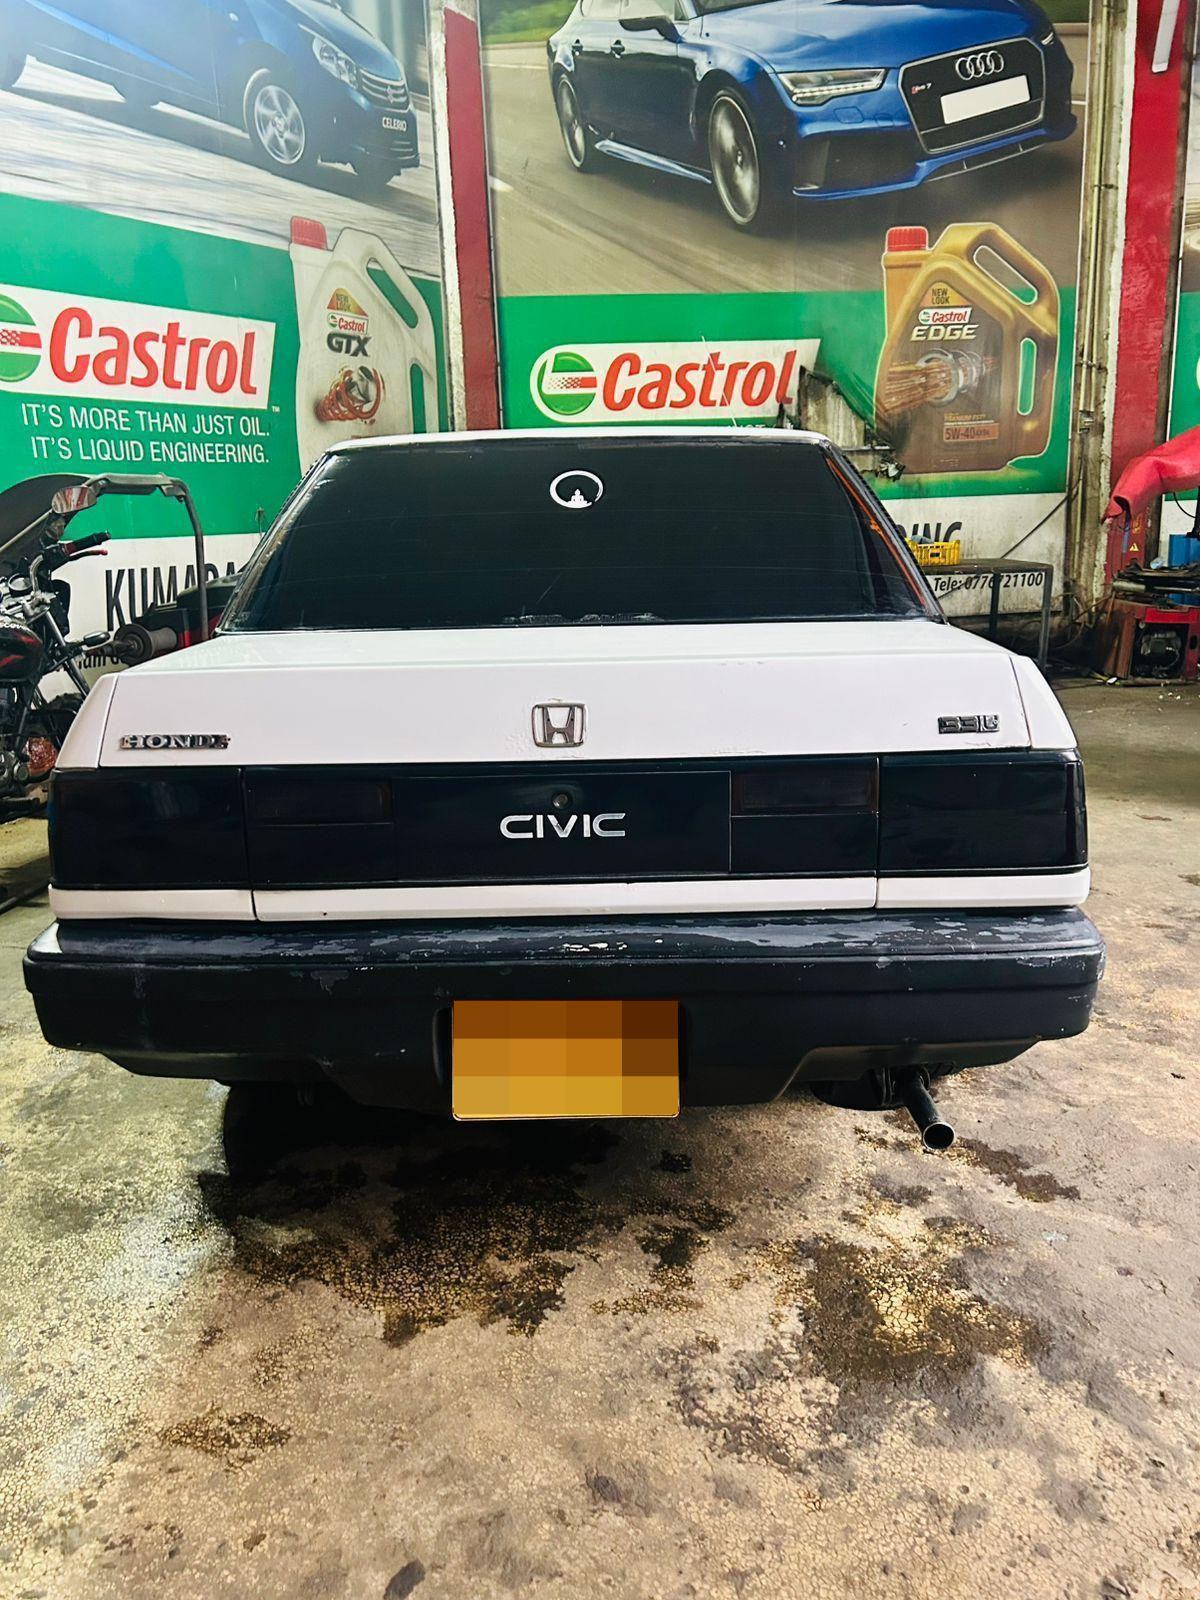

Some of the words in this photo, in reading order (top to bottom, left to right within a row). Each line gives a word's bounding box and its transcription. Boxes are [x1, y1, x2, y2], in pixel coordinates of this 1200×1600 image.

[932, 288, 948, 296] NEW
[338, 318, 365, 333] Castrol
[932, 311, 967, 323] Castrol
[326, 332, 372, 357] GTX
[911, 325, 979, 342] EDGE
[50, 307, 257, 395] Castrol
[602, 350, 797, 412] Castrol
[21, 403, 63, 428] IT'S
[70, 406, 131, 431] MORE
[135, 410, 187, 433] THAN
[192, 414, 234, 436] JUST
[240, 416, 270, 436] OIL.
[31, 436, 72, 461] IT'S
[78, 438, 144, 462] LIQUID
[151, 441, 269, 464] ENGINEERING.
[934, 576, 962, 592] Tele:
[499, 812, 626, 839] CIVIC
